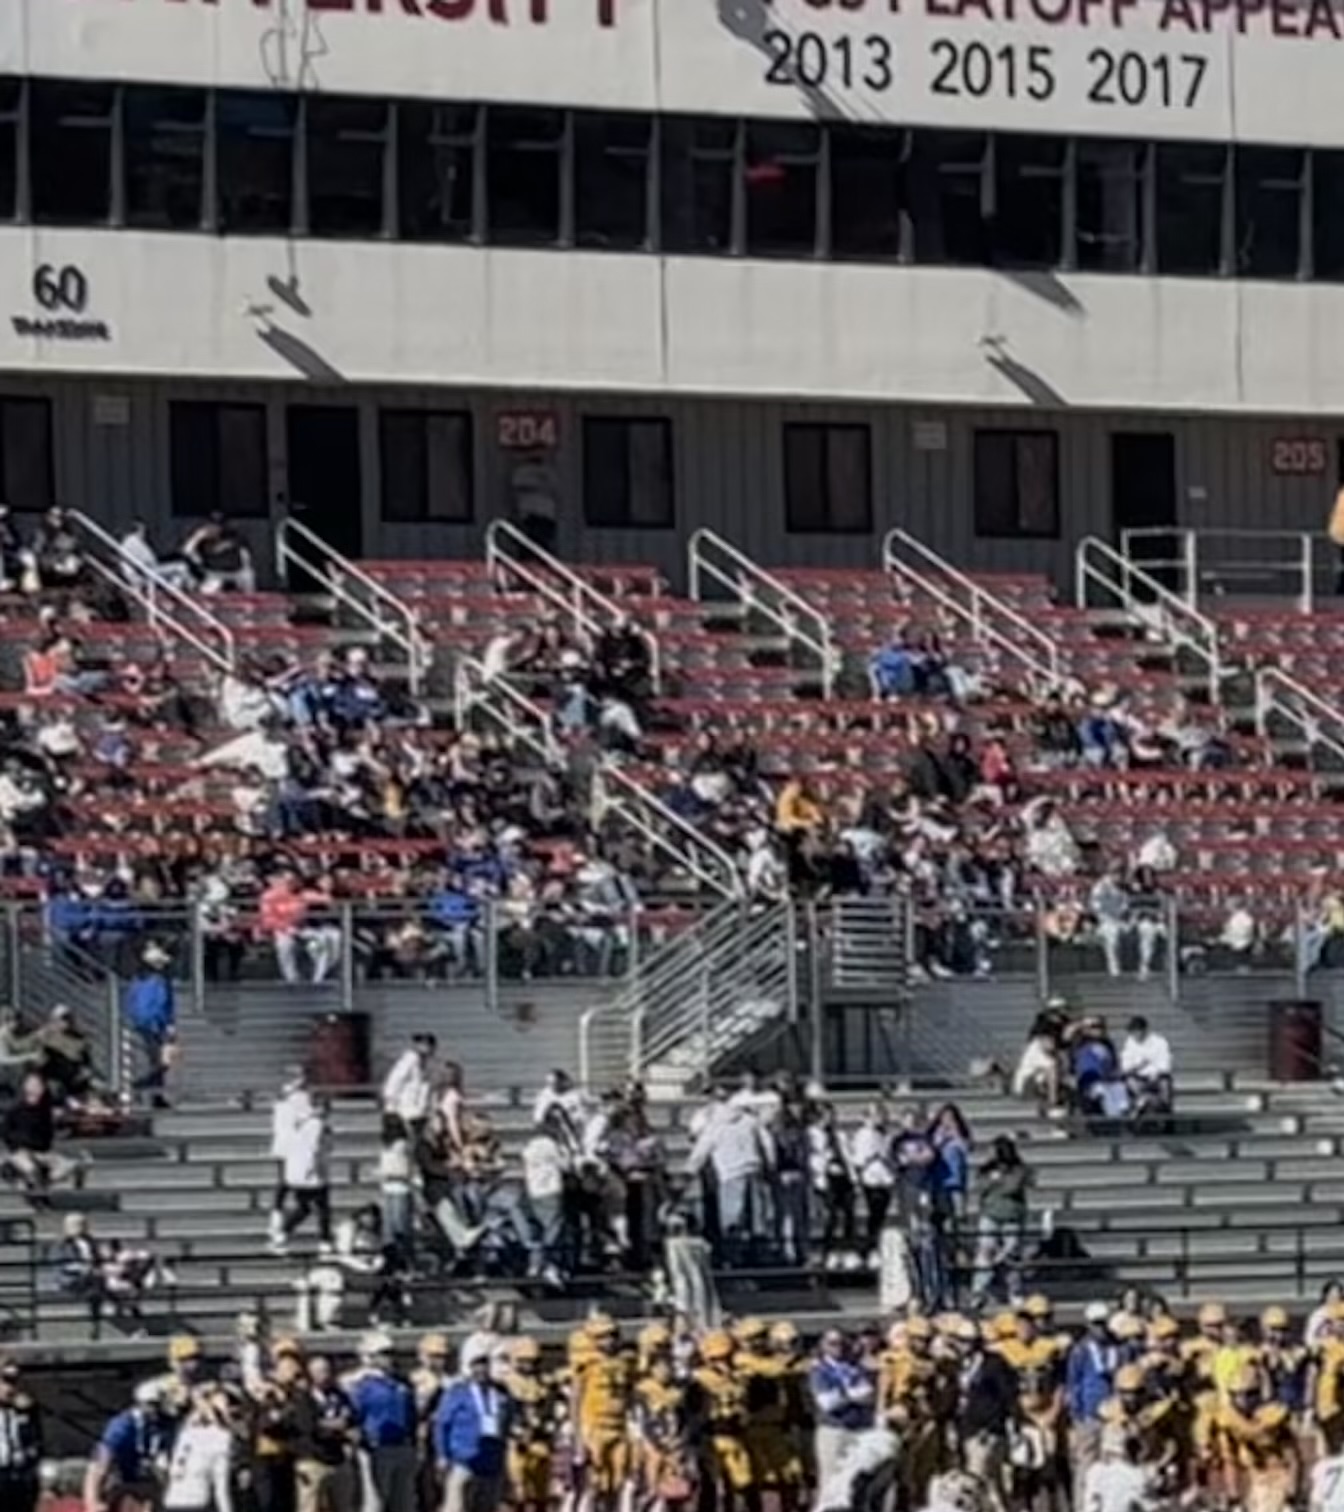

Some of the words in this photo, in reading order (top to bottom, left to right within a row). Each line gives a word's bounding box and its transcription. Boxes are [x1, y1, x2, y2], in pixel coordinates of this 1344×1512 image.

[763, 30, 893, 91] 2013
[930, 39, 1055, 100] 2015
[1086, 48, 1208, 108] 2017
[33, 264, 88, 314] 60
[499, 416, 556, 446] 204
[1274, 441, 1325, 471] 205
